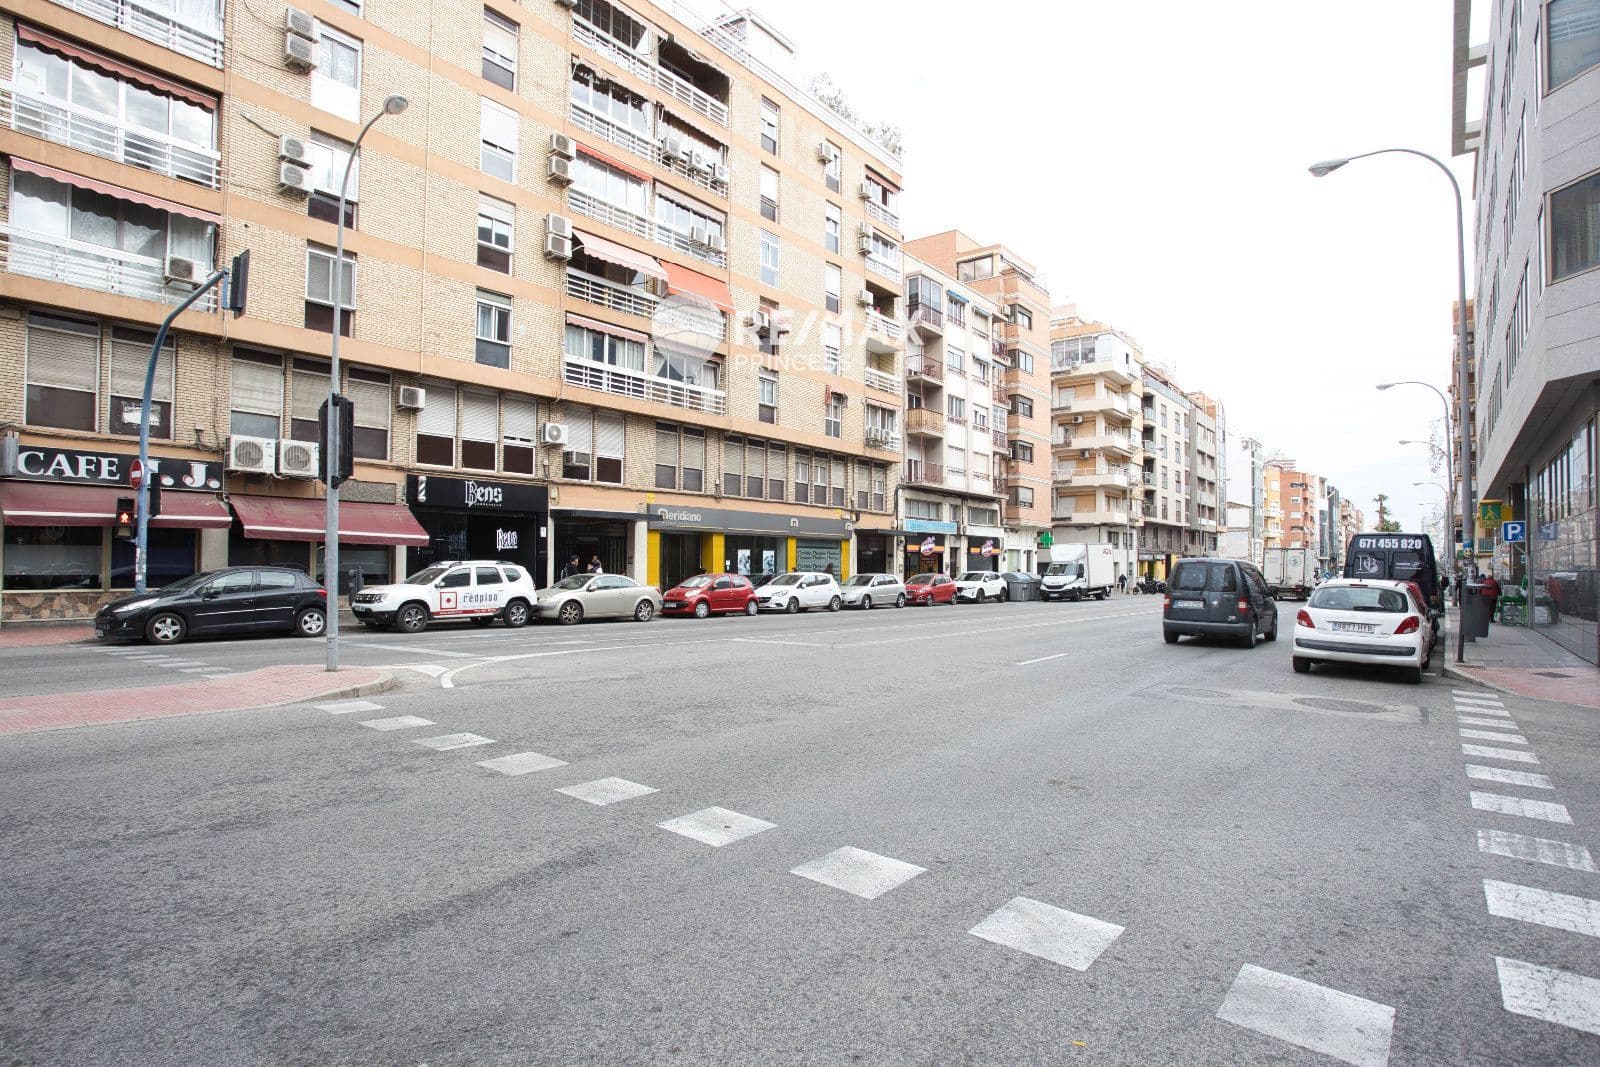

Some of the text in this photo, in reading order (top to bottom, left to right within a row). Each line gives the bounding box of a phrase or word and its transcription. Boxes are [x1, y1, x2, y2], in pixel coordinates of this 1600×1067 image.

[17, 451, 120, 480] CAFE
[465, 480, 503, 507] Bens
[1507, 523, 1522, 540] P
[1359, 538, 1422, 550] 671 455 820
